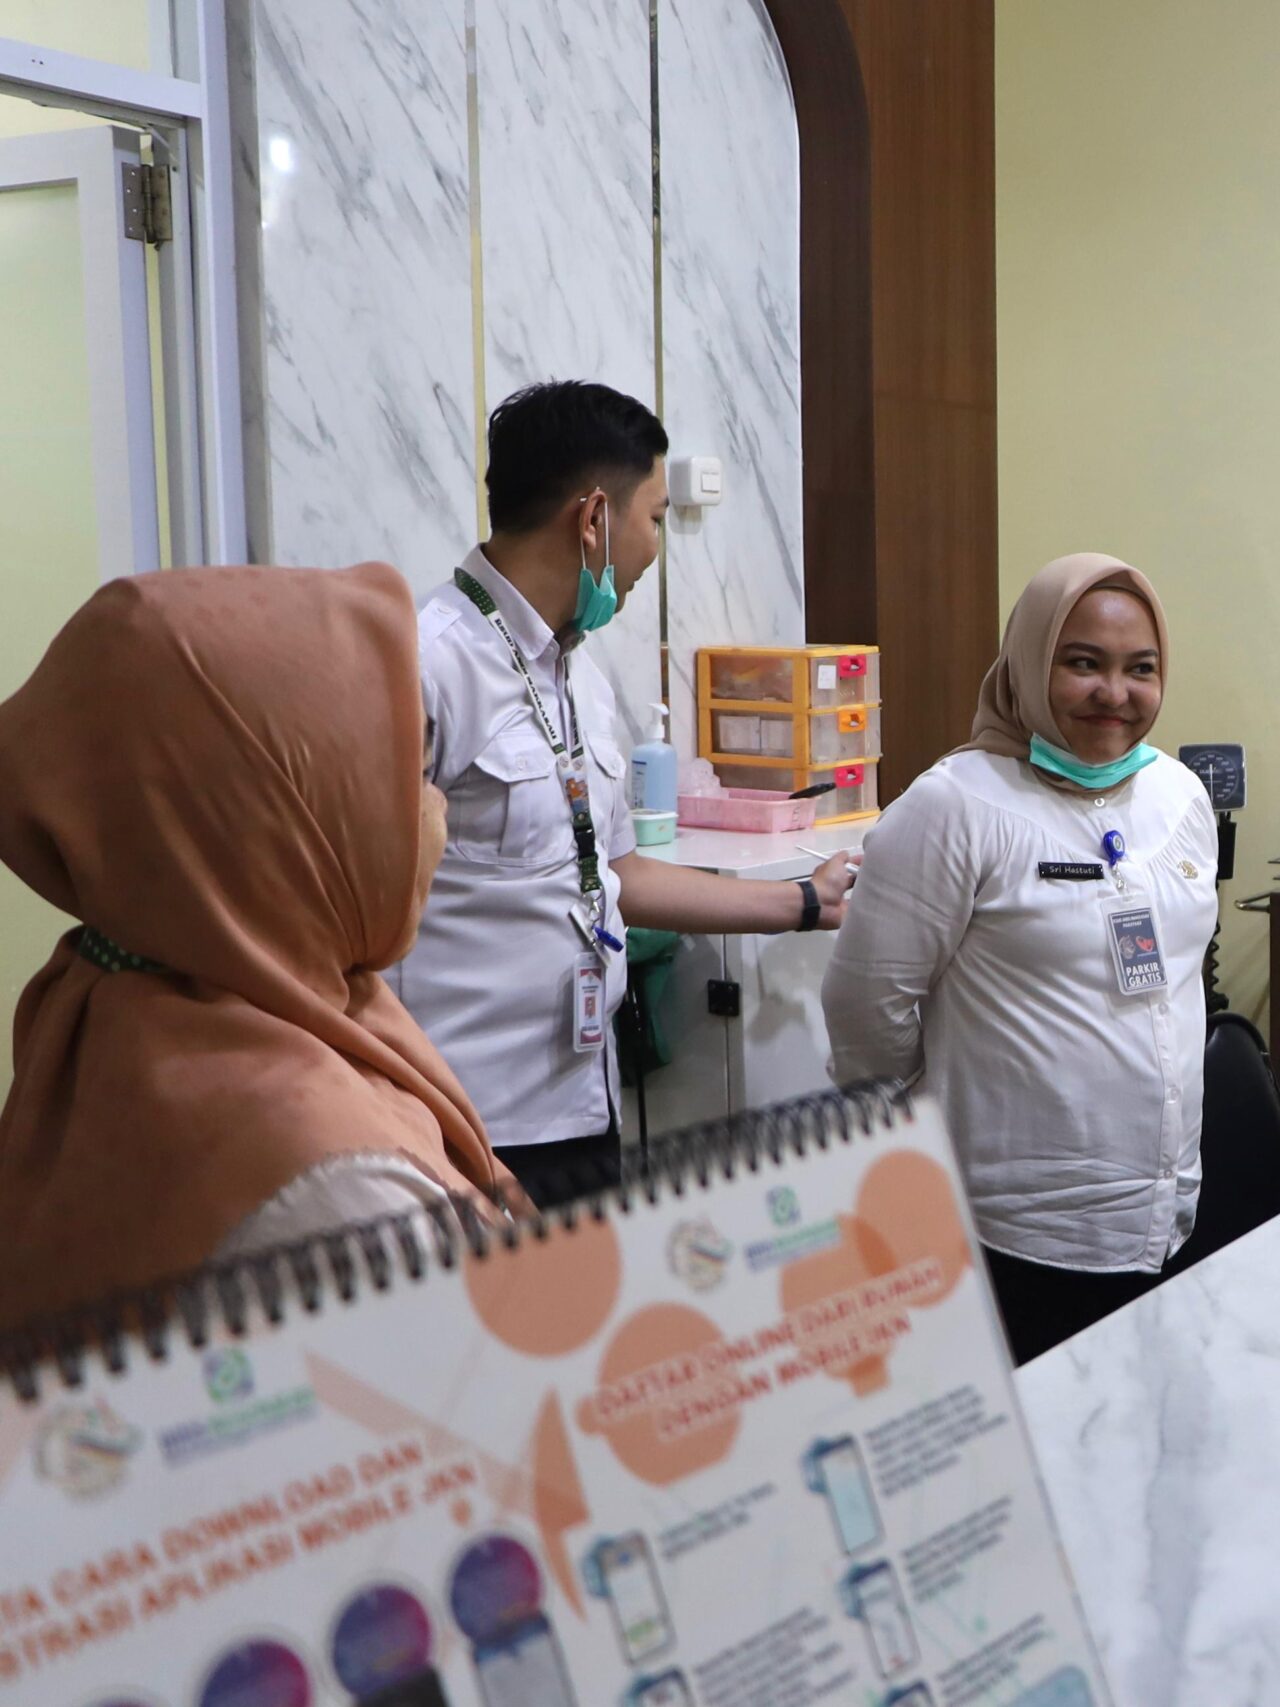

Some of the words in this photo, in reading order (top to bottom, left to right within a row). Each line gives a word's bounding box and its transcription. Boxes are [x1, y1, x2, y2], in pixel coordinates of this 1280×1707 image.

[1049, 866, 1062, 874] Sri
[1064, 866, 1095, 875] Hastuti
[1126, 962, 1160, 976] PARKIR
[1129, 971, 1161, 986] GRATIS
[421, 1461, 479, 1506] JKN
[50, 1539, 158, 1608] CARA
[357, 1440, 426, 1485] DAN
